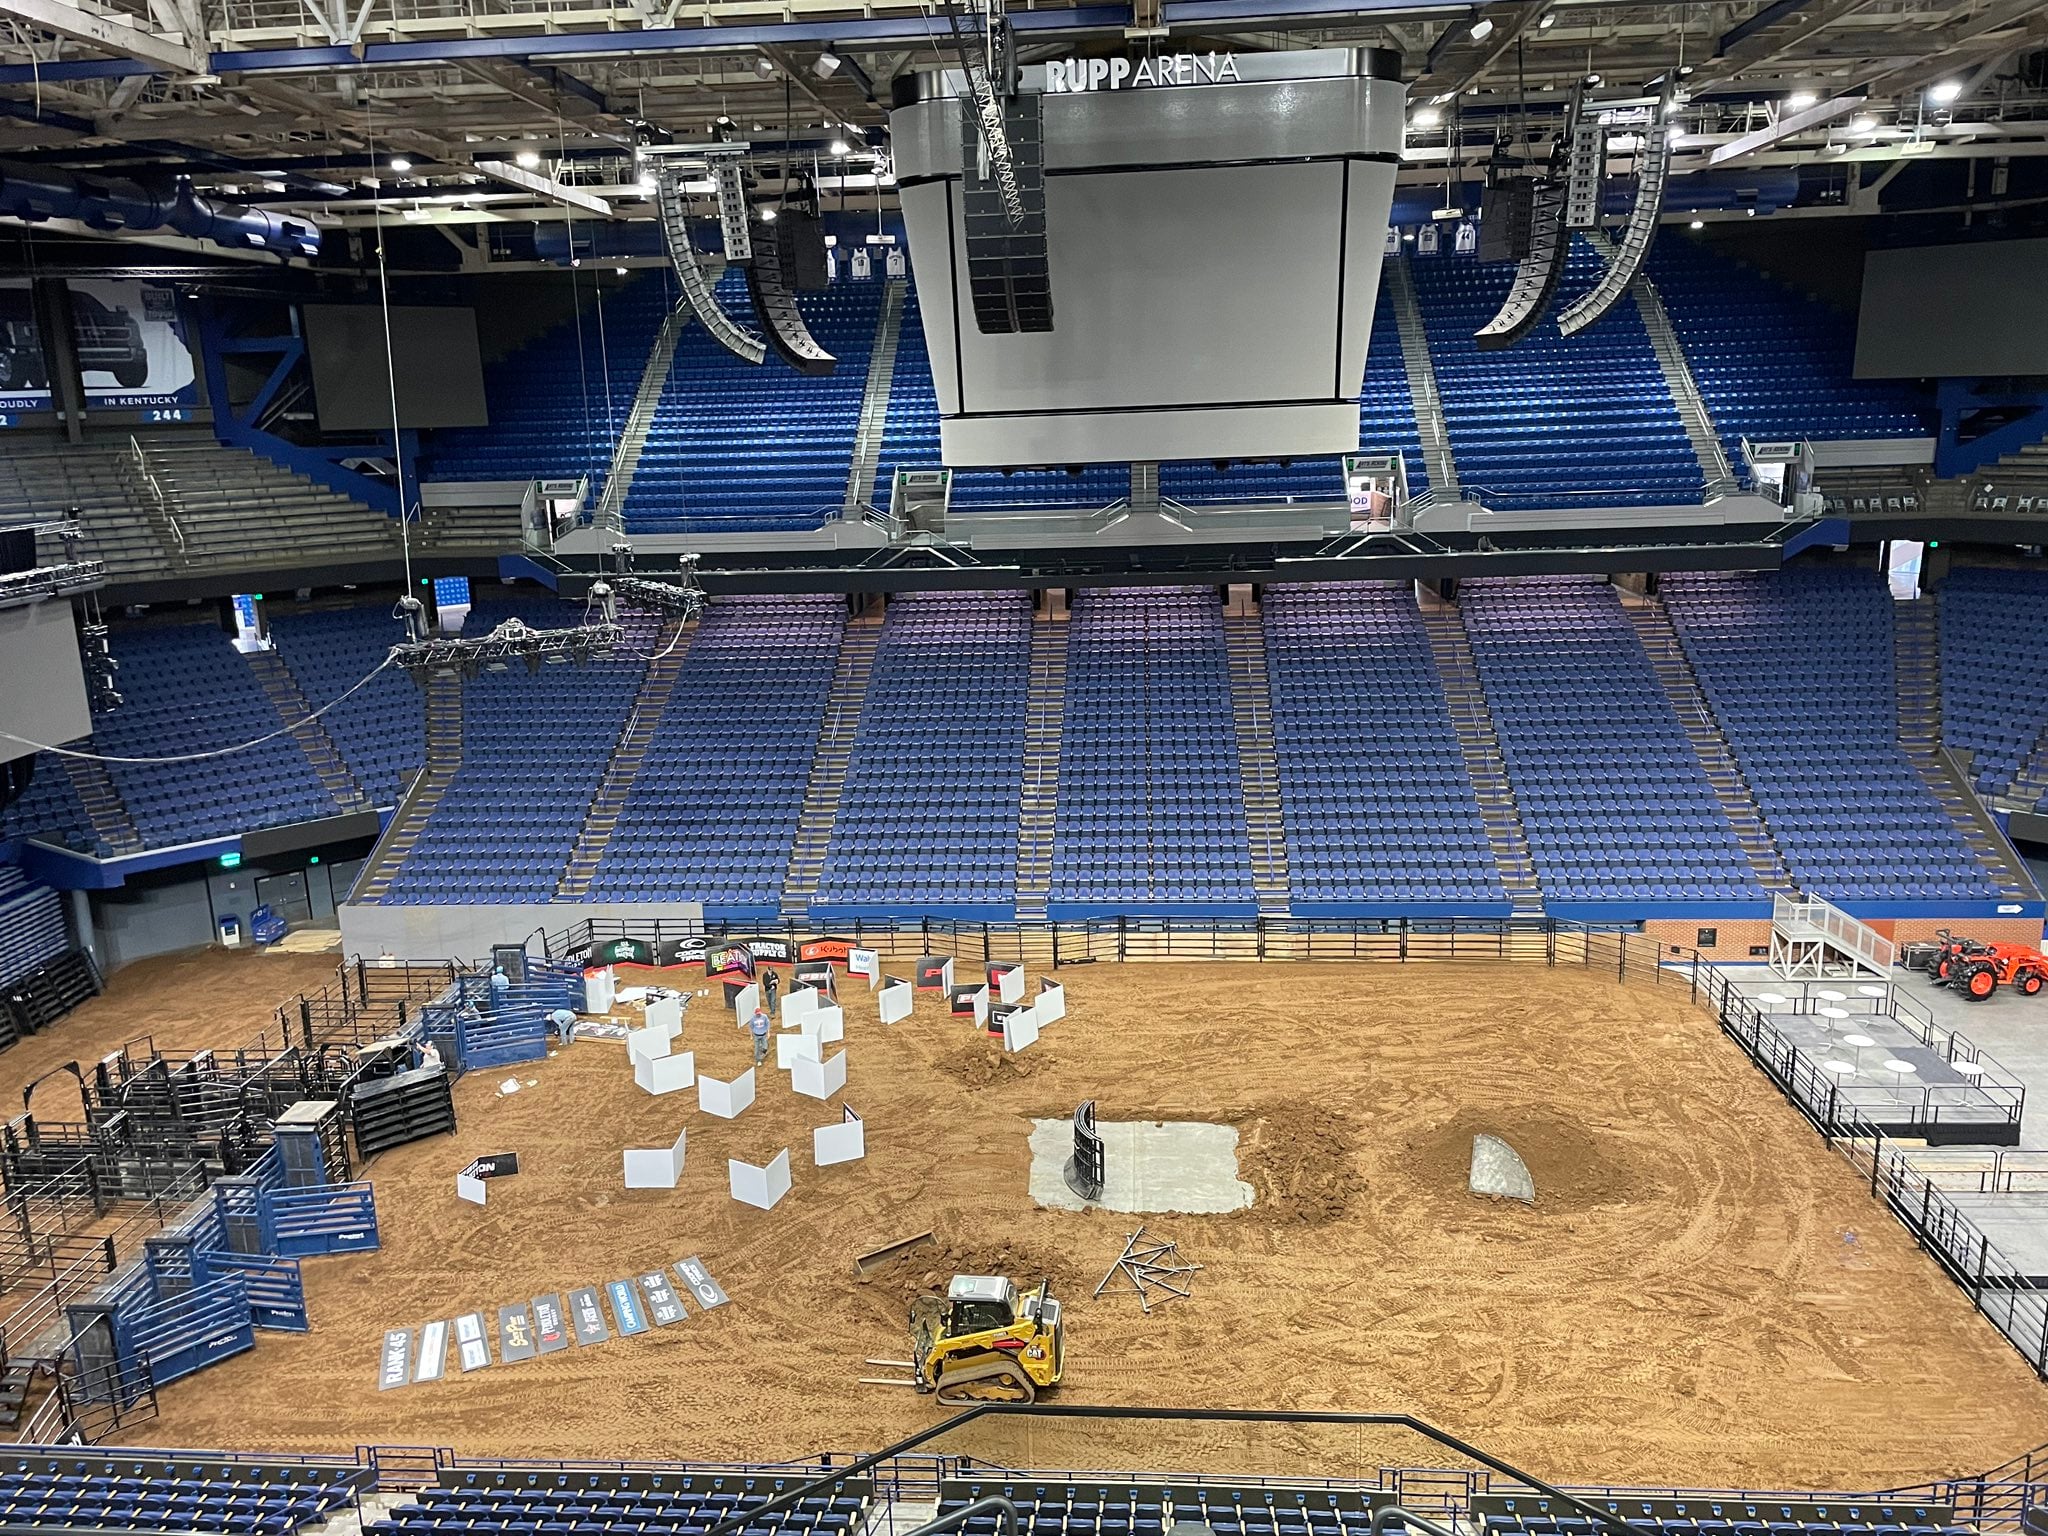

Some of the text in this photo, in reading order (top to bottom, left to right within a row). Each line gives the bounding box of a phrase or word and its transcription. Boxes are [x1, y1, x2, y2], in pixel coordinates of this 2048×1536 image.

[1046, 53, 1241, 93] RUPP ARENA
[104, 396, 179, 406] IN KENTUCKY
[152, 410, 182, 421] 244
[748, 942, 787, 952] TRACTOR
[820, 945, 849, 954] Kubot
[566, 946, 593, 963] DLETON
[674, 949, 706, 957] COOPE
[613, 1284, 637, 1329] CAMPING WORLD
[536, 1303, 552, 1335] PENDLETON
[1026, 1348, 1042, 1359] CAT
